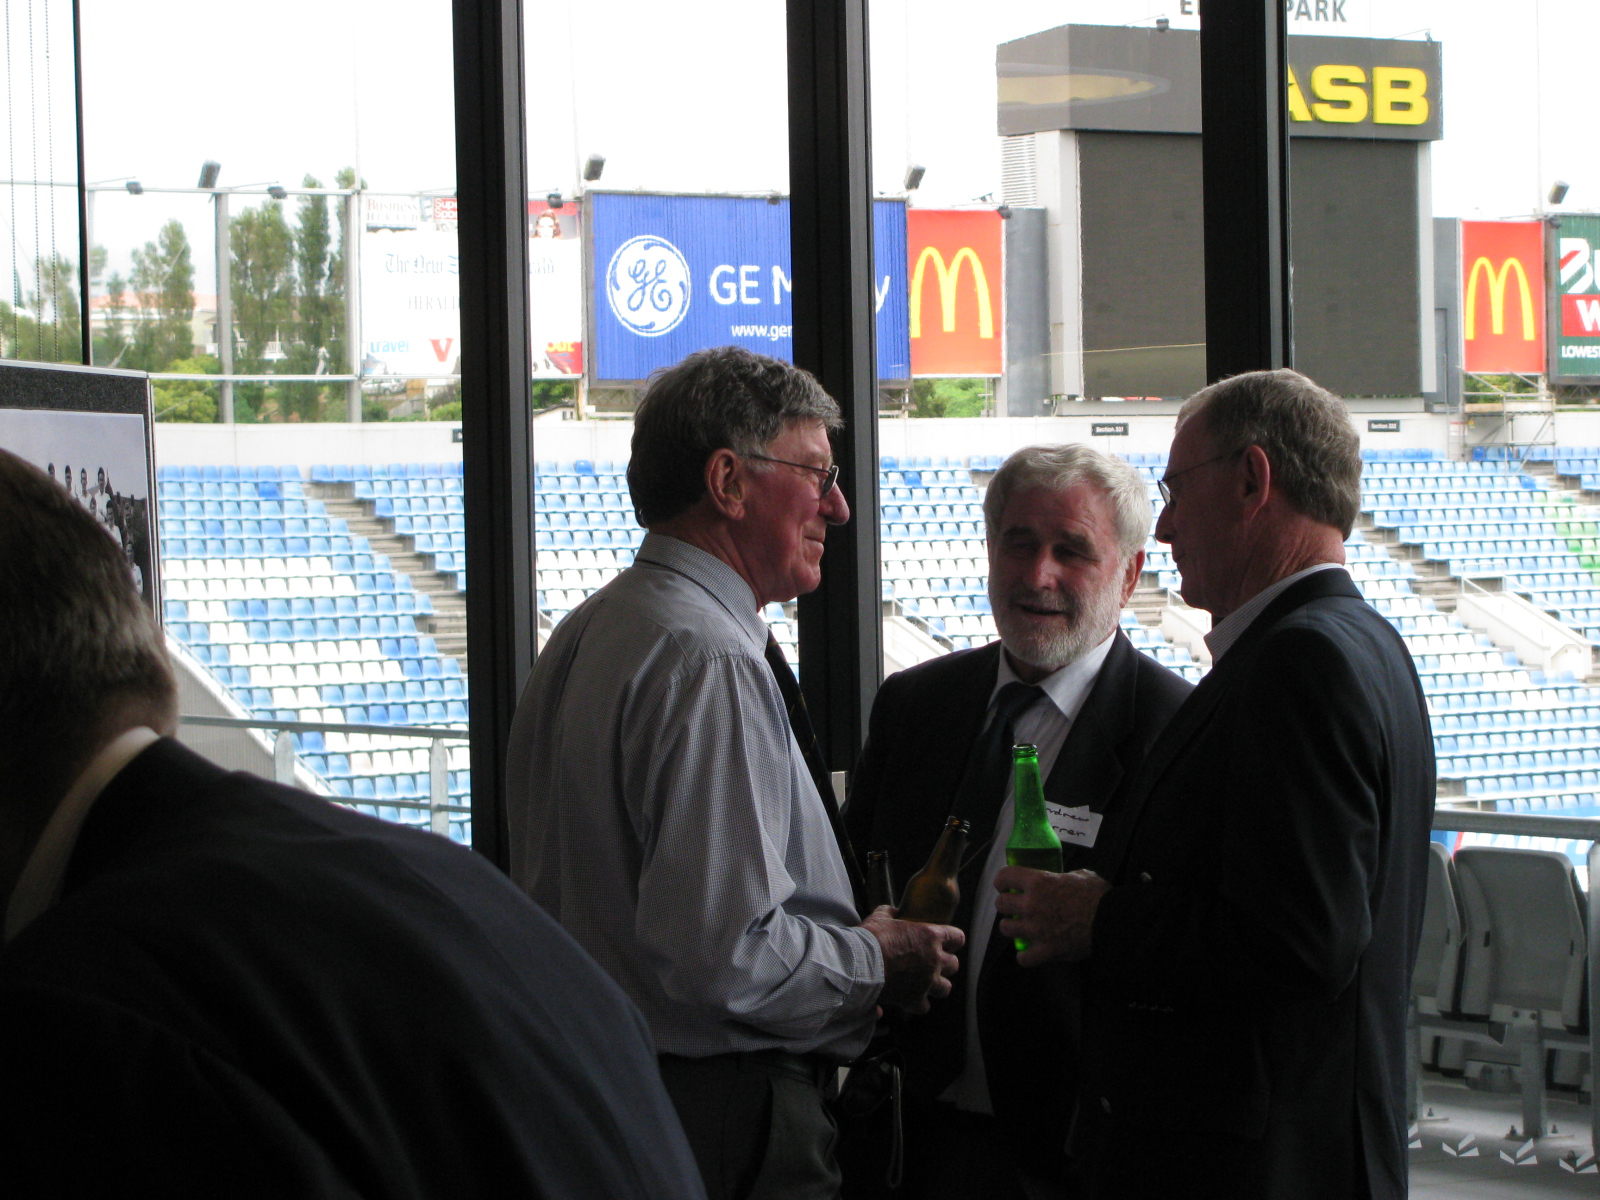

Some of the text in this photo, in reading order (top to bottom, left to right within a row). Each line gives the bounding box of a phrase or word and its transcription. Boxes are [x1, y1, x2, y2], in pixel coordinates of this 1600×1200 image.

[385, 253, 410, 274] The
[709, 265, 760, 305] GE
[1046, 808, 1090, 821] ndrew
